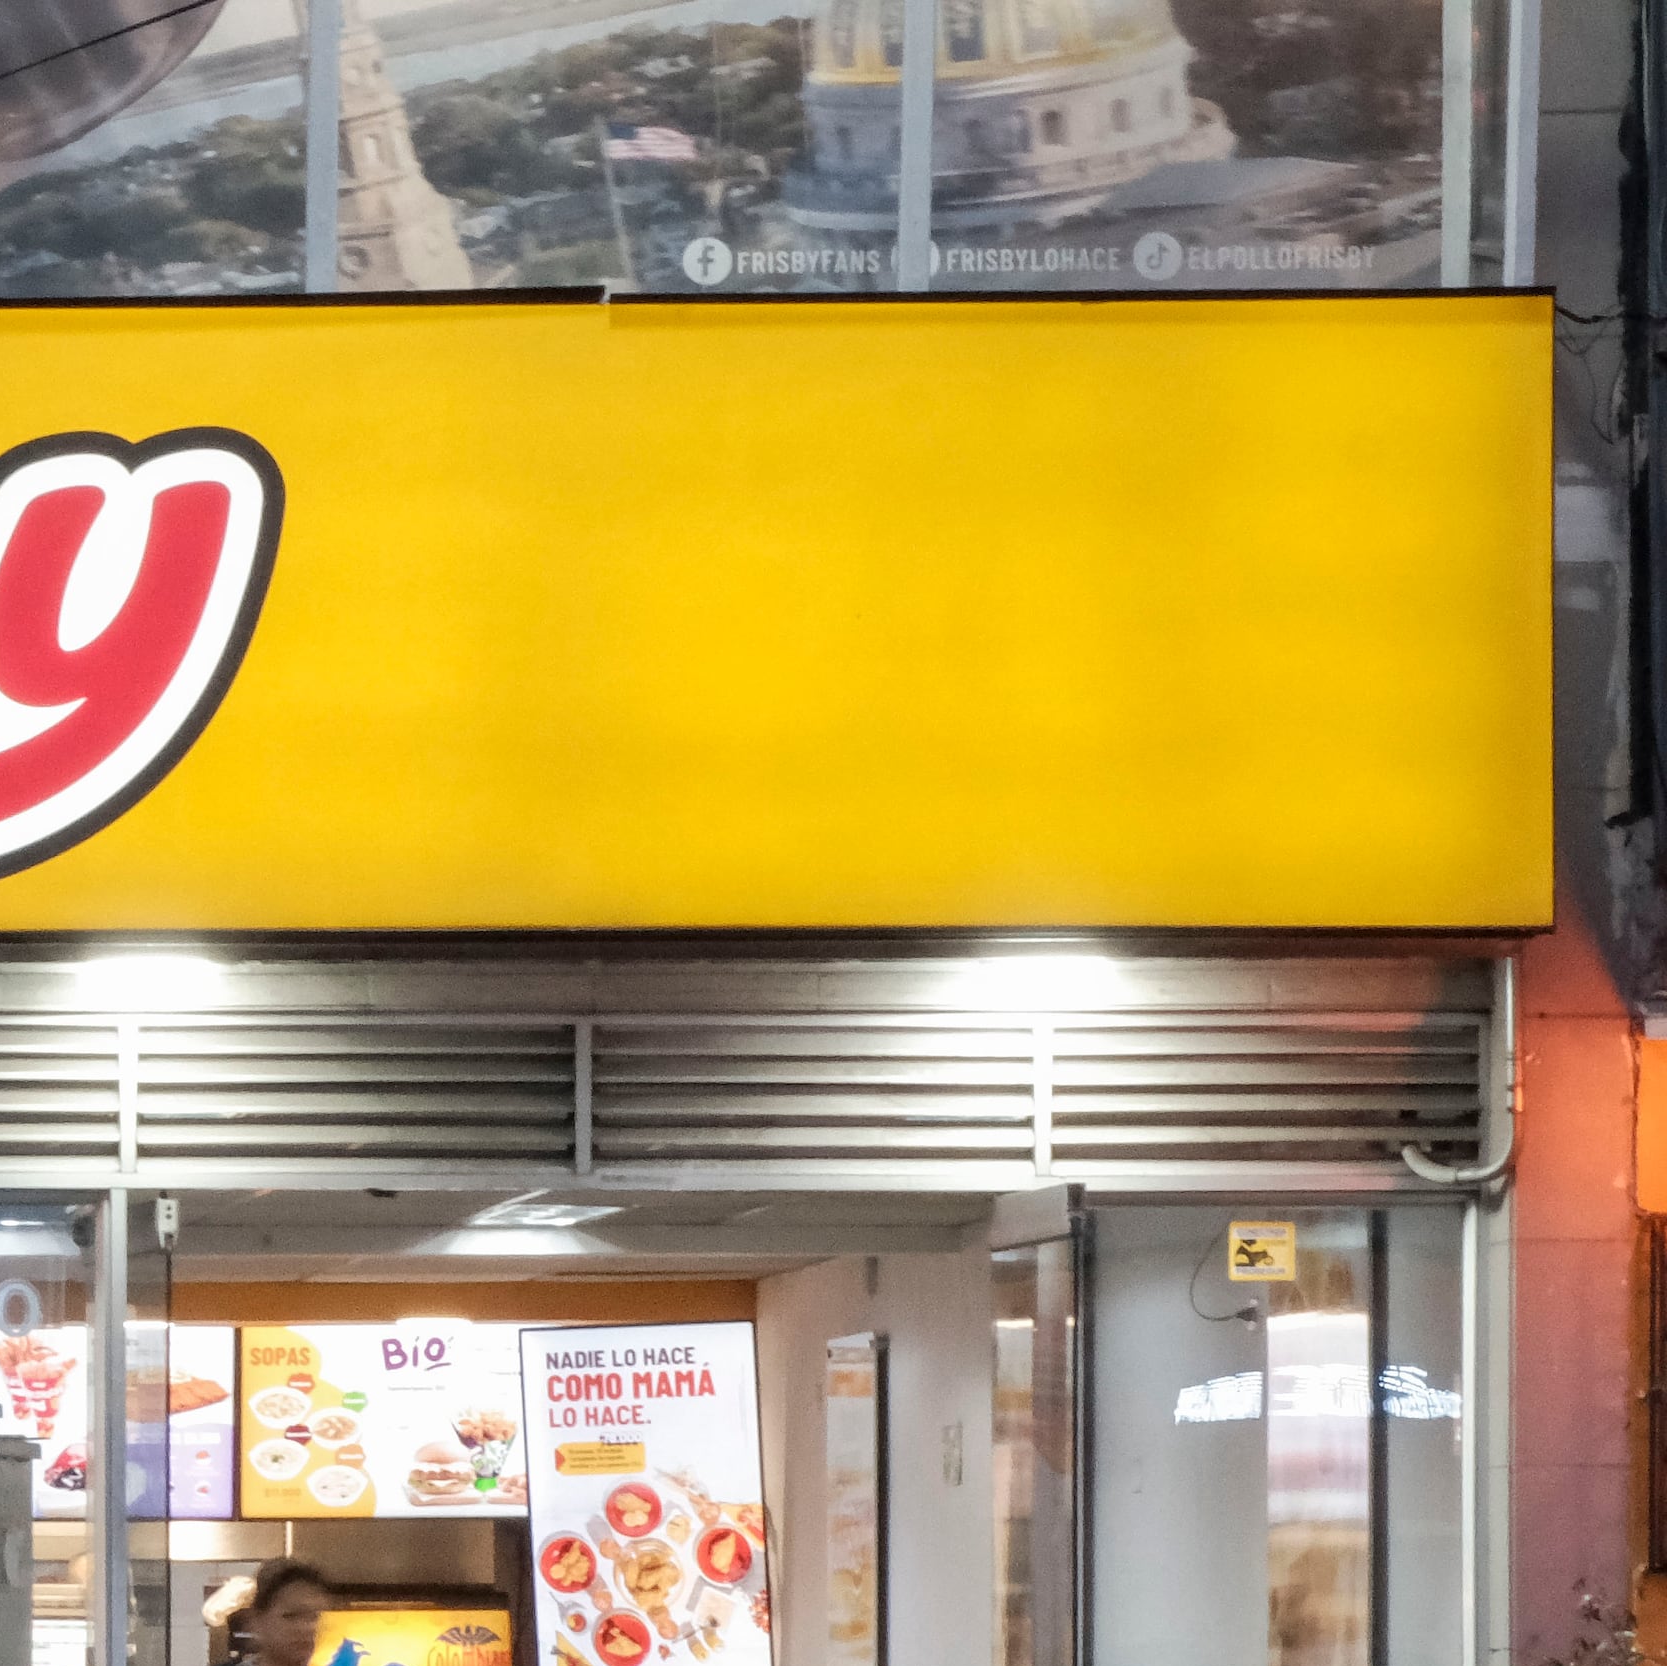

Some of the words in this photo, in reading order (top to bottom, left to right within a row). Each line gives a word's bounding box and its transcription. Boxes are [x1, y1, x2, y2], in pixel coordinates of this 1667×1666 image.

[737, 249, 881, 275] FRISBYFANS
[946, 247, 1121, 273] FRISBYLOHACE
[250, 1346, 312, 1367] SOPAS
[546, 1350, 606, 1370] NADIE
[612, 1348, 637, 1368] LO
[643, 1346, 696, 1366] HACE
[547, 1372, 623, 1402] COMO
[632, 1362, 716, 1399] MAMÁ
[549, 1407, 578, 1428] LO
[585, 1405, 652, 1427] HACE.
